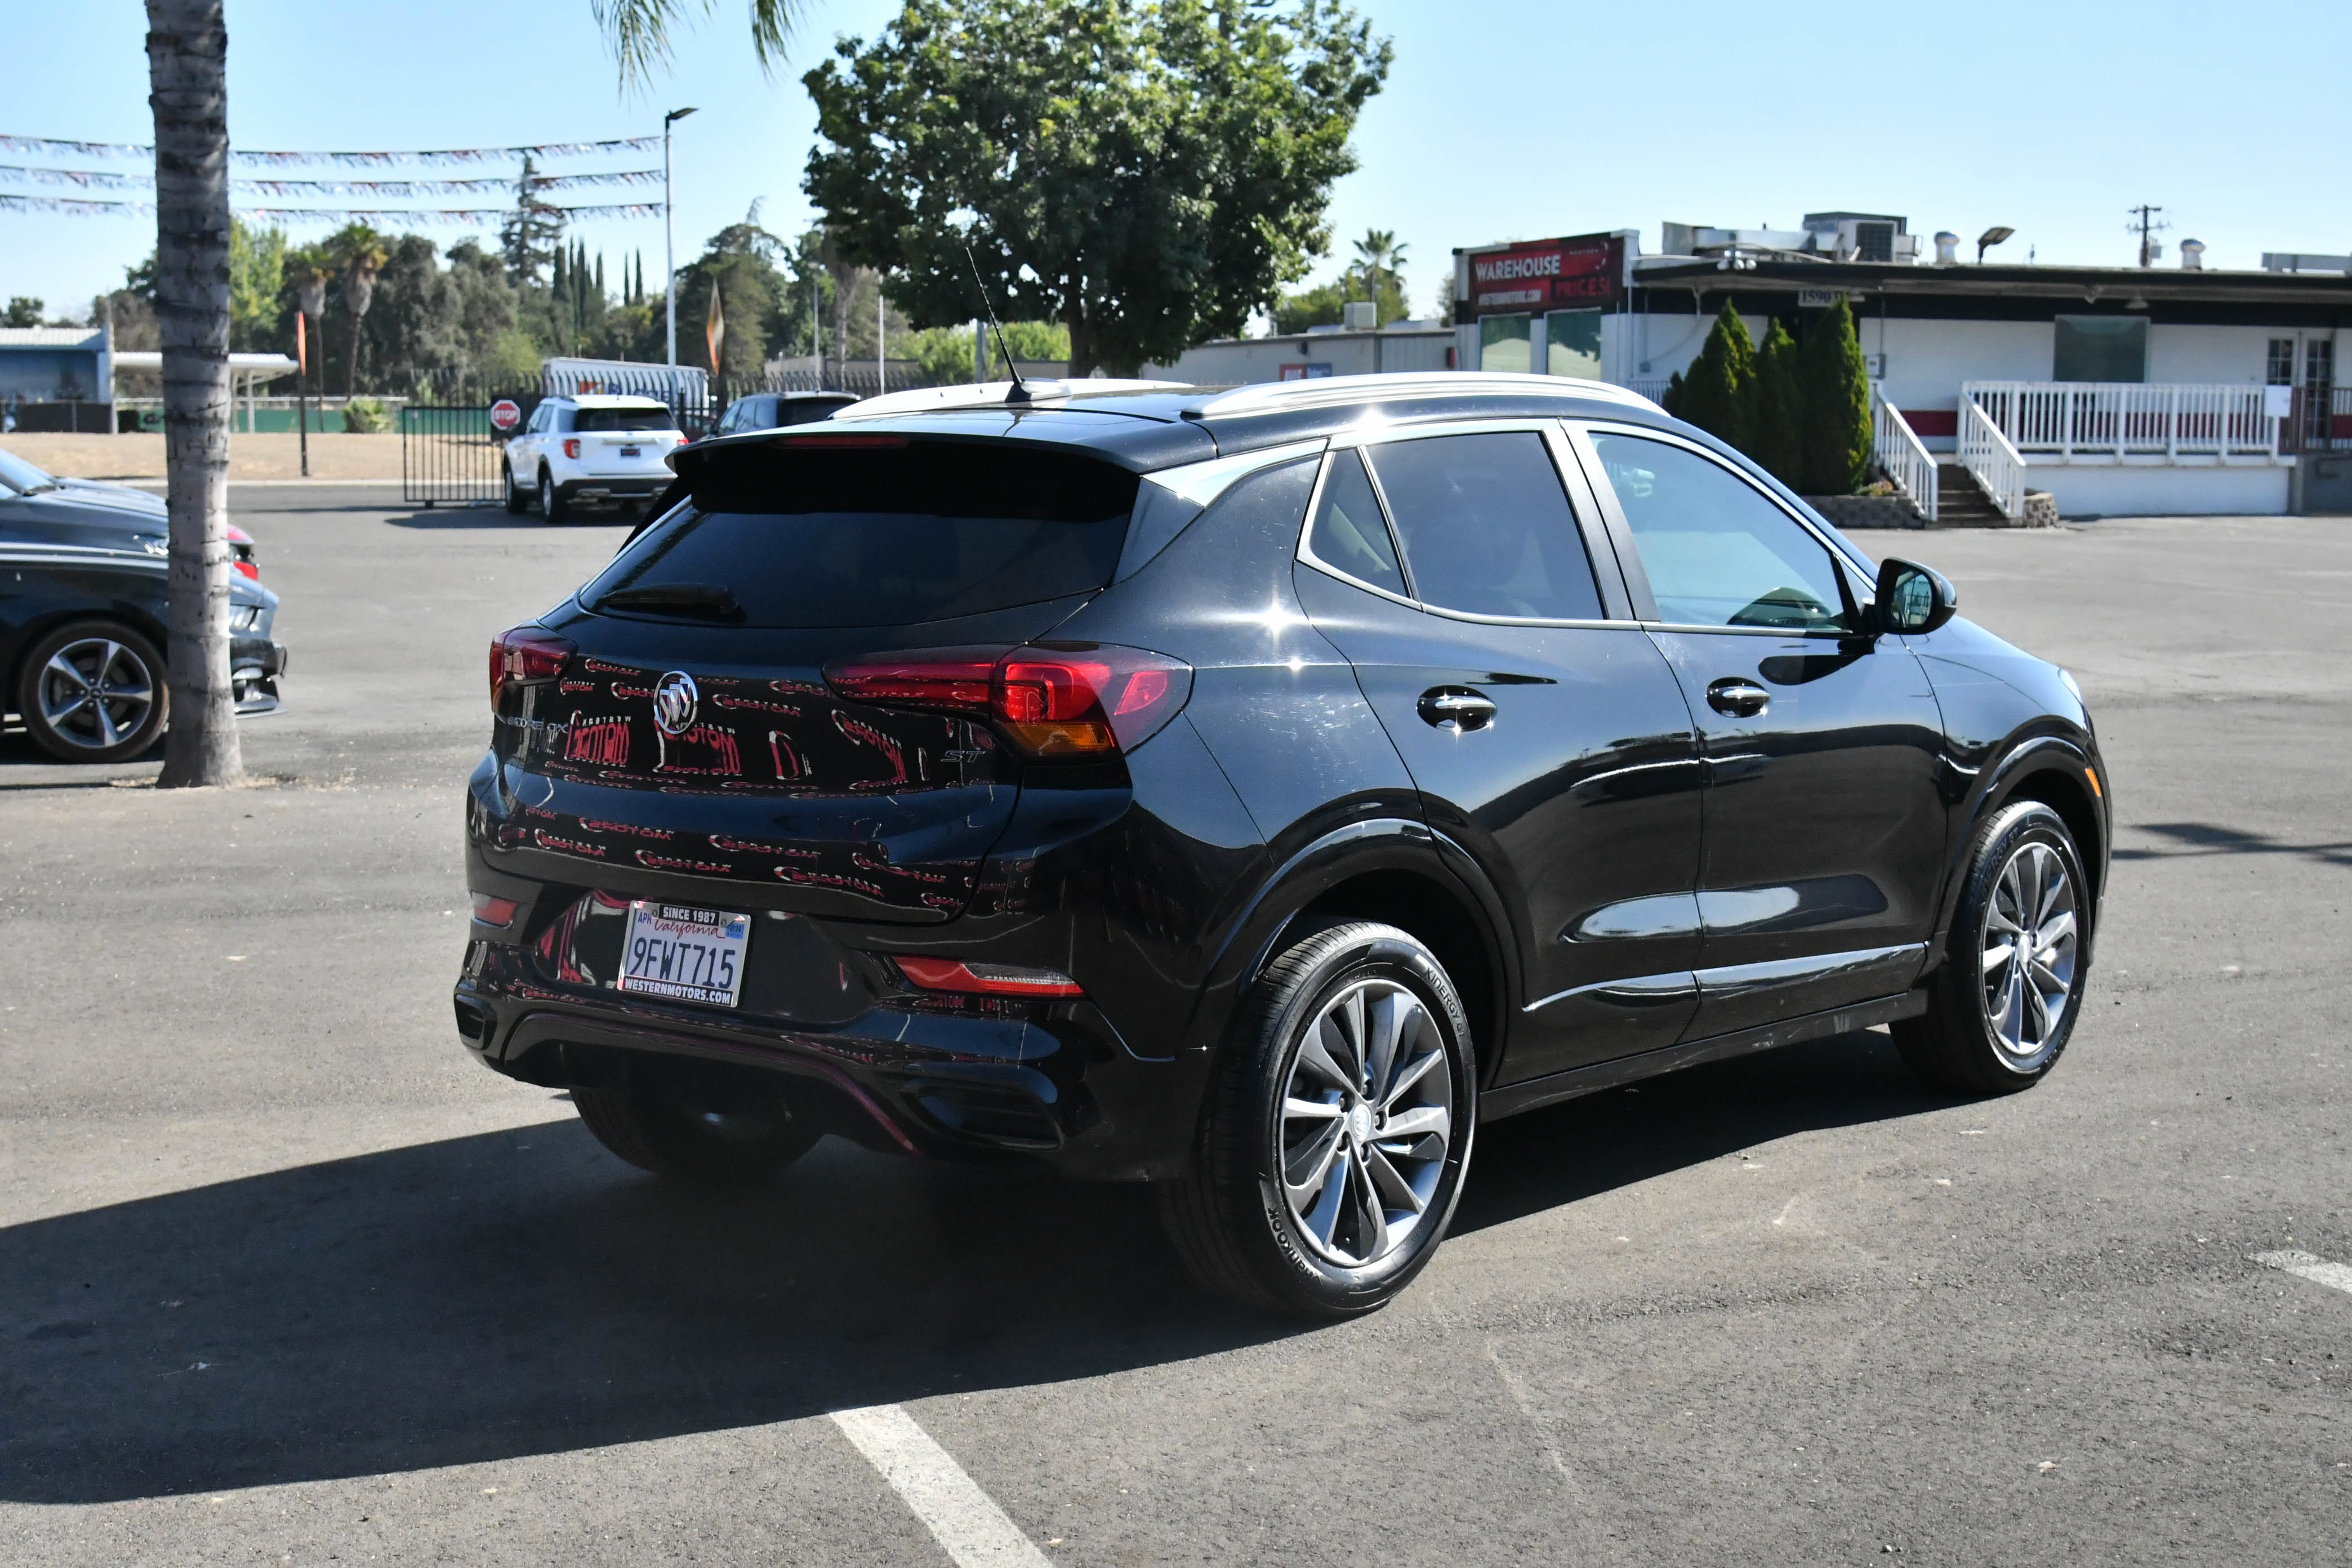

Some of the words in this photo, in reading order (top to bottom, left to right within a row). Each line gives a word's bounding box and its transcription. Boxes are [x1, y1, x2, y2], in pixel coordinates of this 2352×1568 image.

[1475, 255, 1561, 282] WAREHOUSE
[495, 409, 518, 421] STOP
[941, 750, 986, 763] ST
[663, 906, 690, 919] SINCE
[693, 910, 716, 923] 1987
[629, 937, 736, 989] 9FWT715
[625, 978, 732, 1005] WESTERNMOTORS.COM
[1424, 967, 1460, 1018] KINERGY
